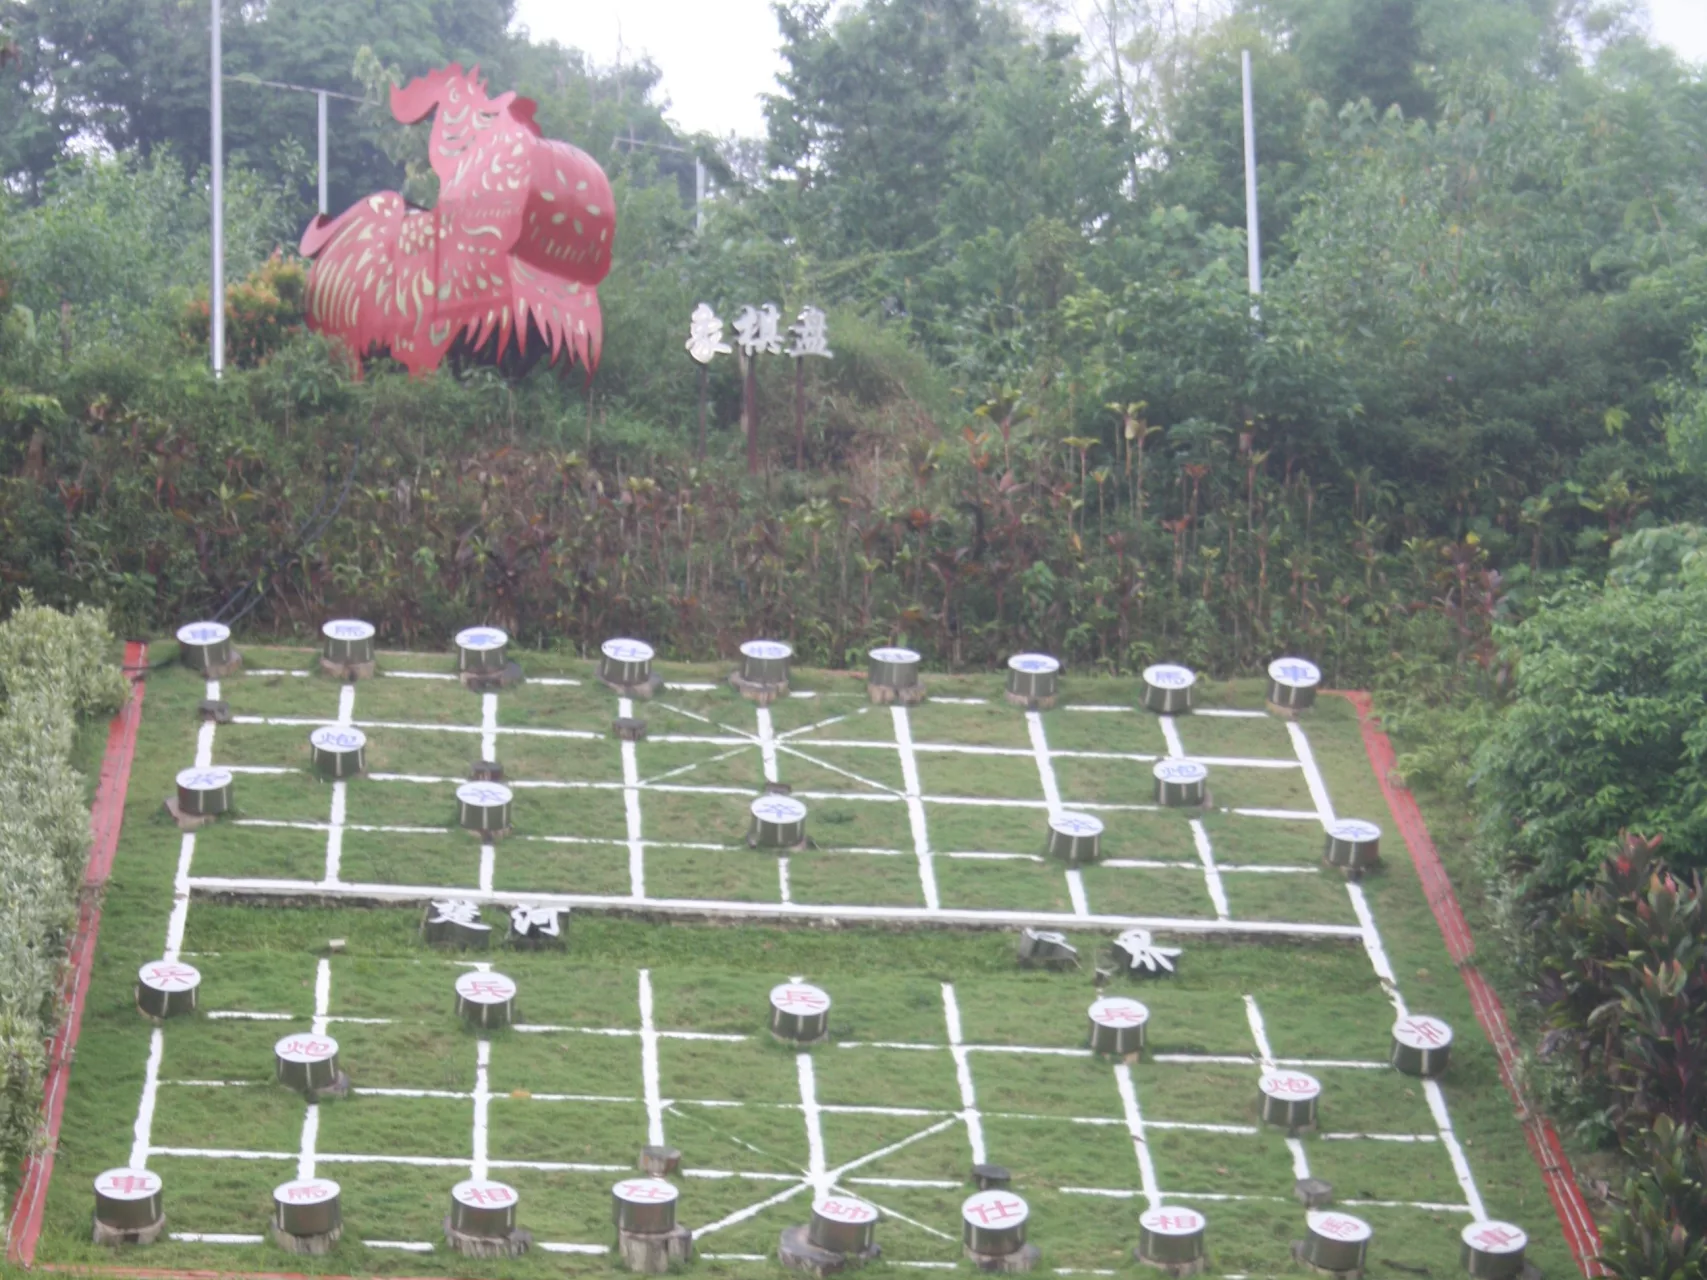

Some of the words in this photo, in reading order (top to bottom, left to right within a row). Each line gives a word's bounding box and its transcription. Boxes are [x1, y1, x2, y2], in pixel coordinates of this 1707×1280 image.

[684, 301, 834, 364] 象棋盘
[146, 965, 194, 987] 兵
[459, 980, 511, 1000] 兵
[775, 990, 826, 1009] 兵
[1094, 1007, 1145, 1023] 兵
[280, 1041, 334, 1057] 炮
[1266, 1077, 1317, 1094] 炮
[99, 1175, 155, 1194] 車
[622, 1183, 673, 1200] 仕
[462, 1187, 512, 1205] 相
[966, 1199, 1022, 1224] 仕
[1147, 1214, 1196, 1231] 相
